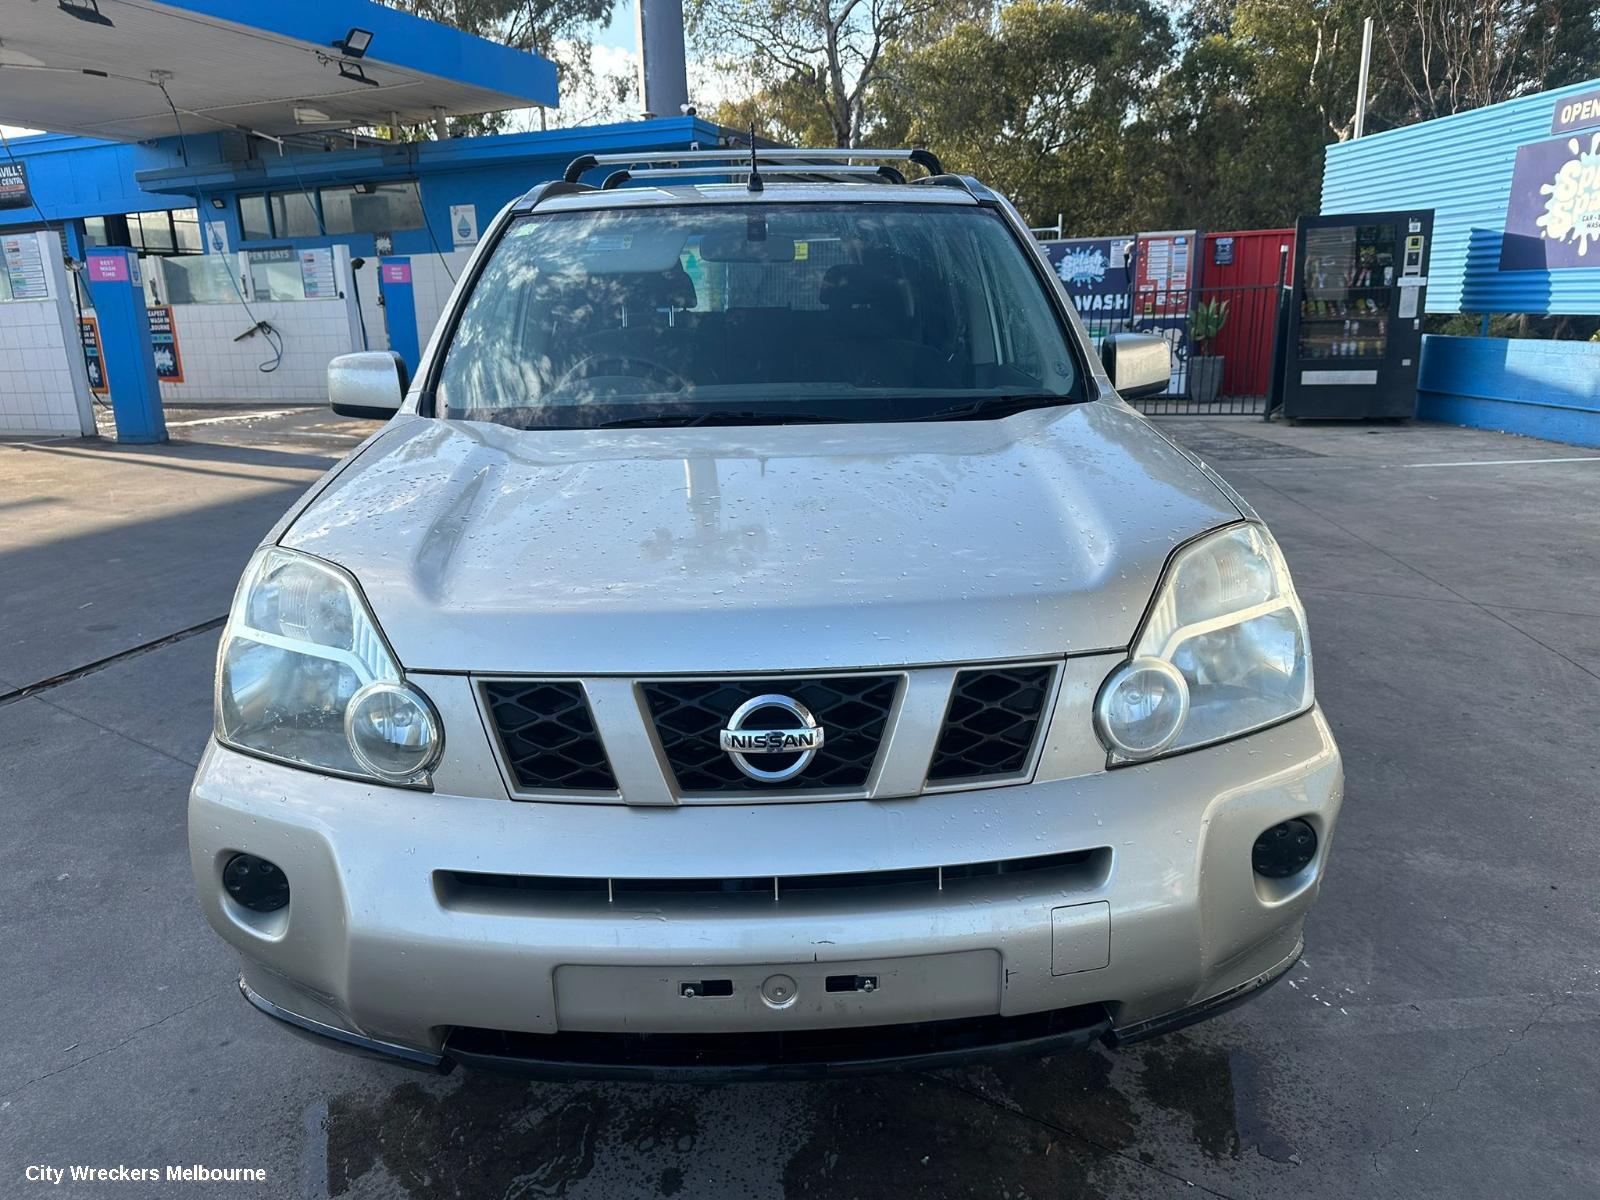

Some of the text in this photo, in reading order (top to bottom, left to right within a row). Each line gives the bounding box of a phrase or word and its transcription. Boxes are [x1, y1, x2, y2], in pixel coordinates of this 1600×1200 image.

[1560, 99, 1600, 124] OPEN
[270, 249, 289, 259] DAYS
[1074, 293, 1128, 312] WASH
[731, 733, 814, 748] NISSAN
